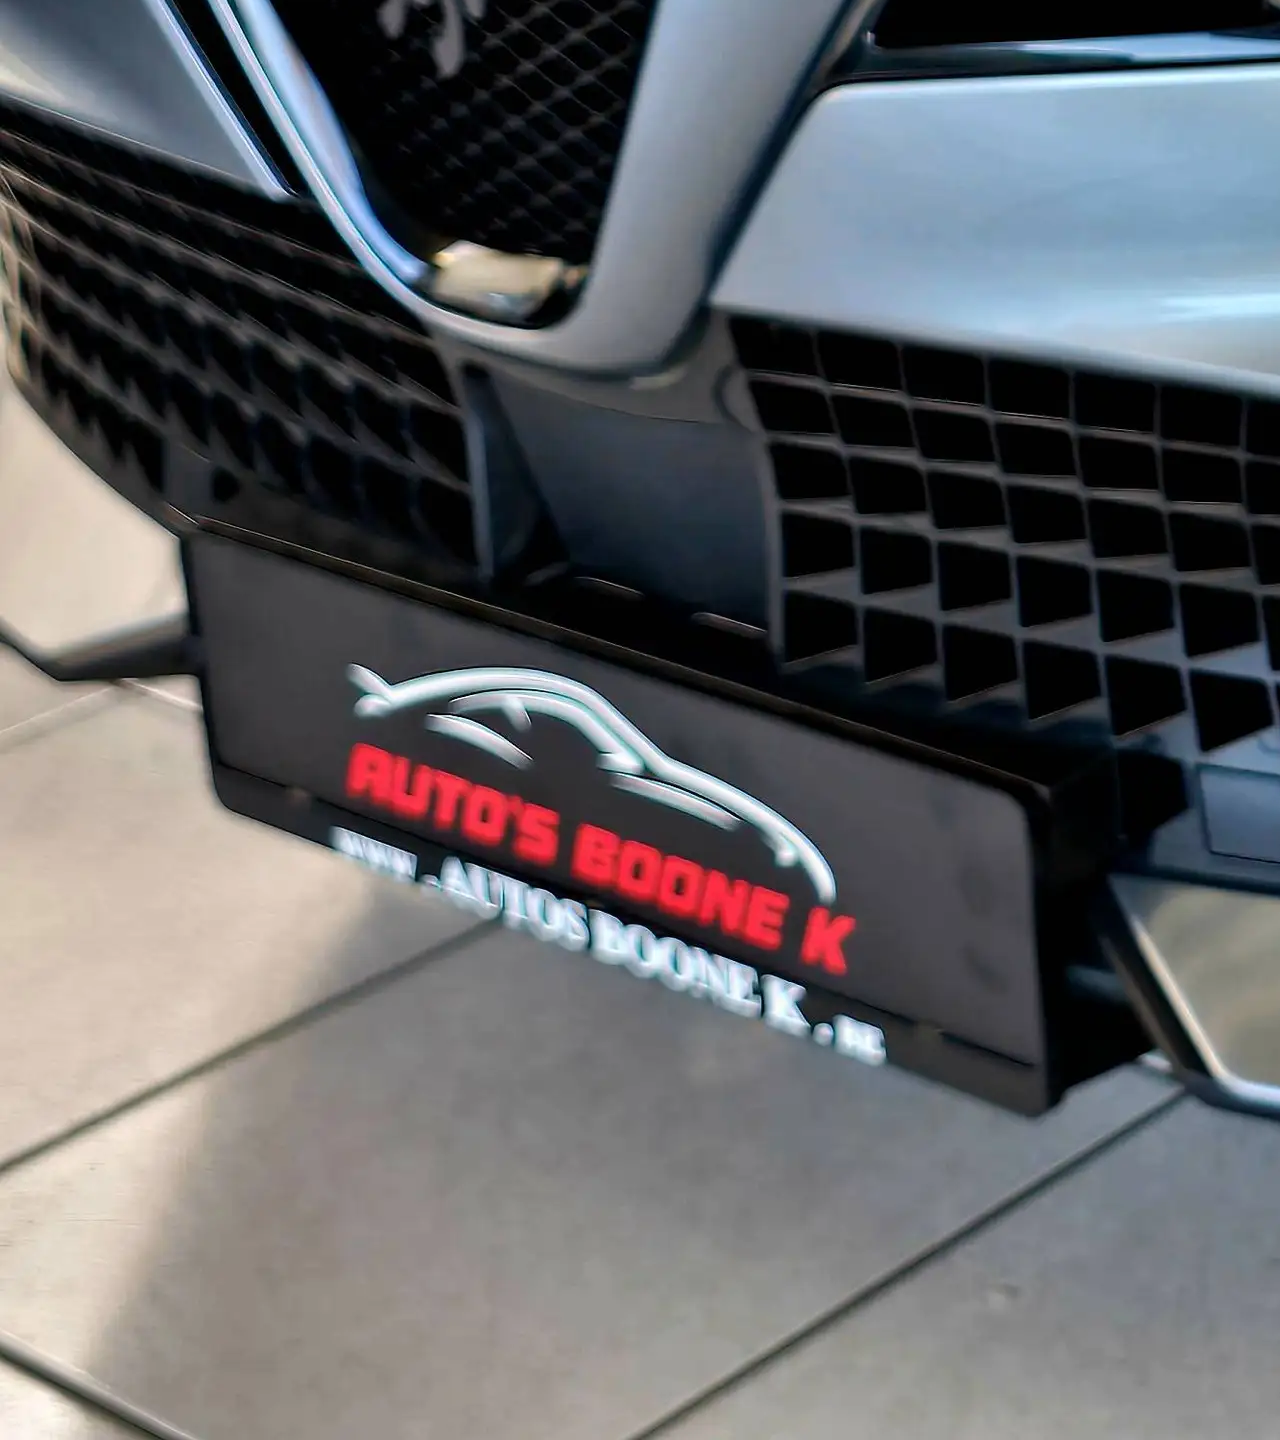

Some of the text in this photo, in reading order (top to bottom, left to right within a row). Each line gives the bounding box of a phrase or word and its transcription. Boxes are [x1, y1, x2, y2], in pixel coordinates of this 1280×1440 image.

[348, 744, 855, 975] AUTO'S BOONE K
